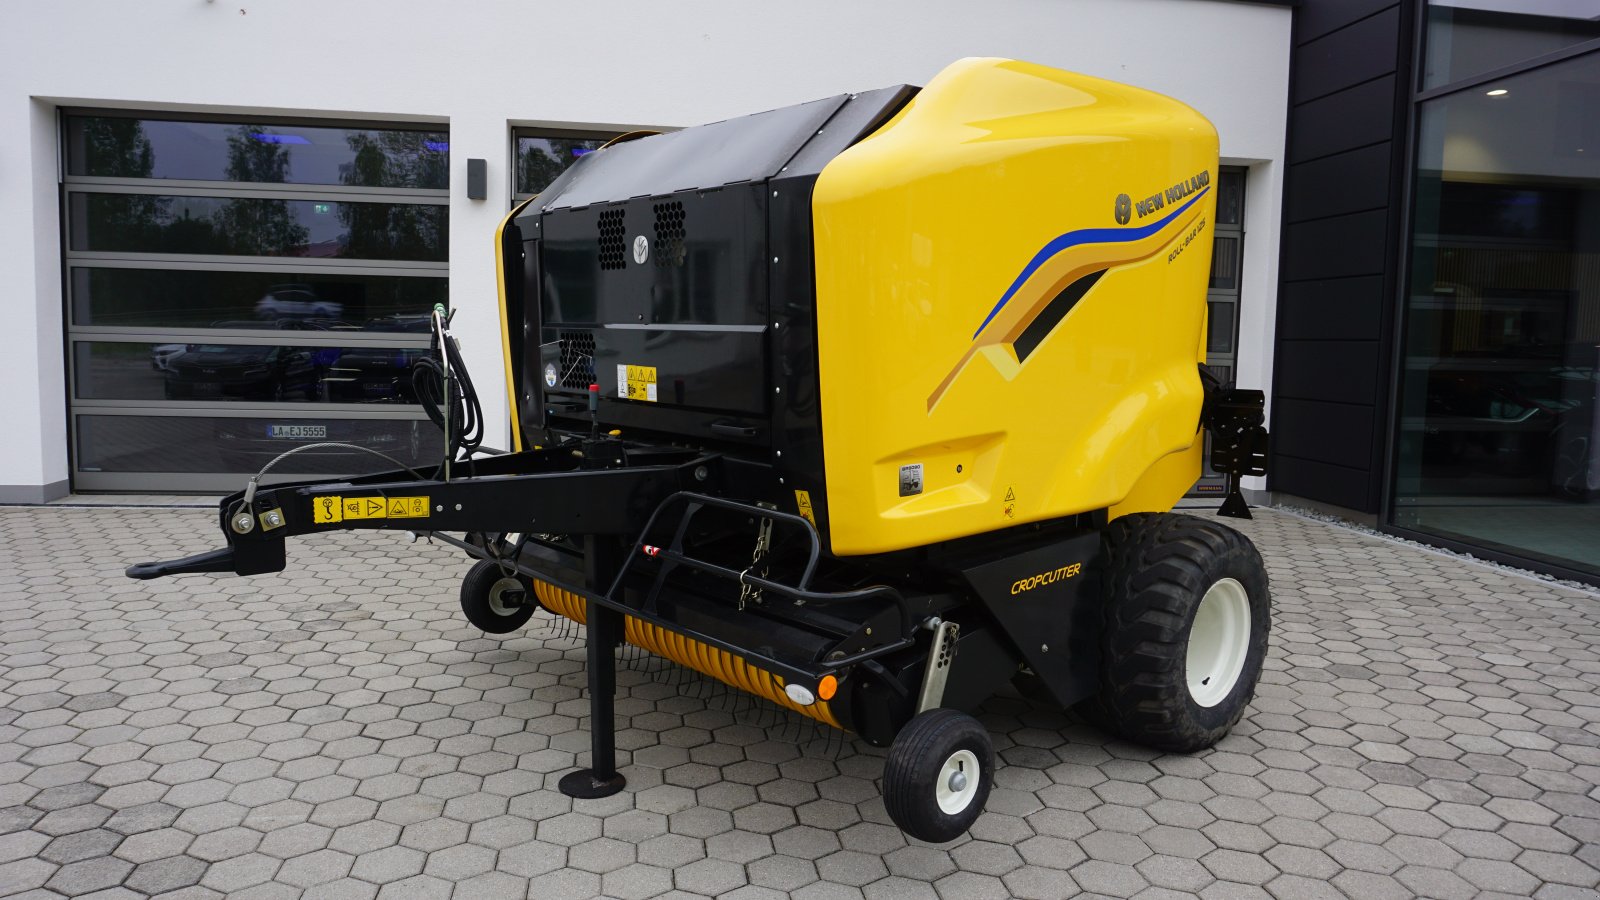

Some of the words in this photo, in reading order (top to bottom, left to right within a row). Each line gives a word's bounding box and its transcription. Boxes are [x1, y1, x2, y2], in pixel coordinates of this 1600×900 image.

[1135, 192, 1164, 218] NEW
[1165, 170, 1210, 205] HOLLAND
[1168, 229, 1197, 264] ROLL-BAR
[1198, 217, 1206, 234] 125
[272, 426, 284, 437] LA
[290, 426, 302, 437] EJ
[303, 426, 325, 437] 5555
[1010, 562, 1082, 595] CROPCUTTER
